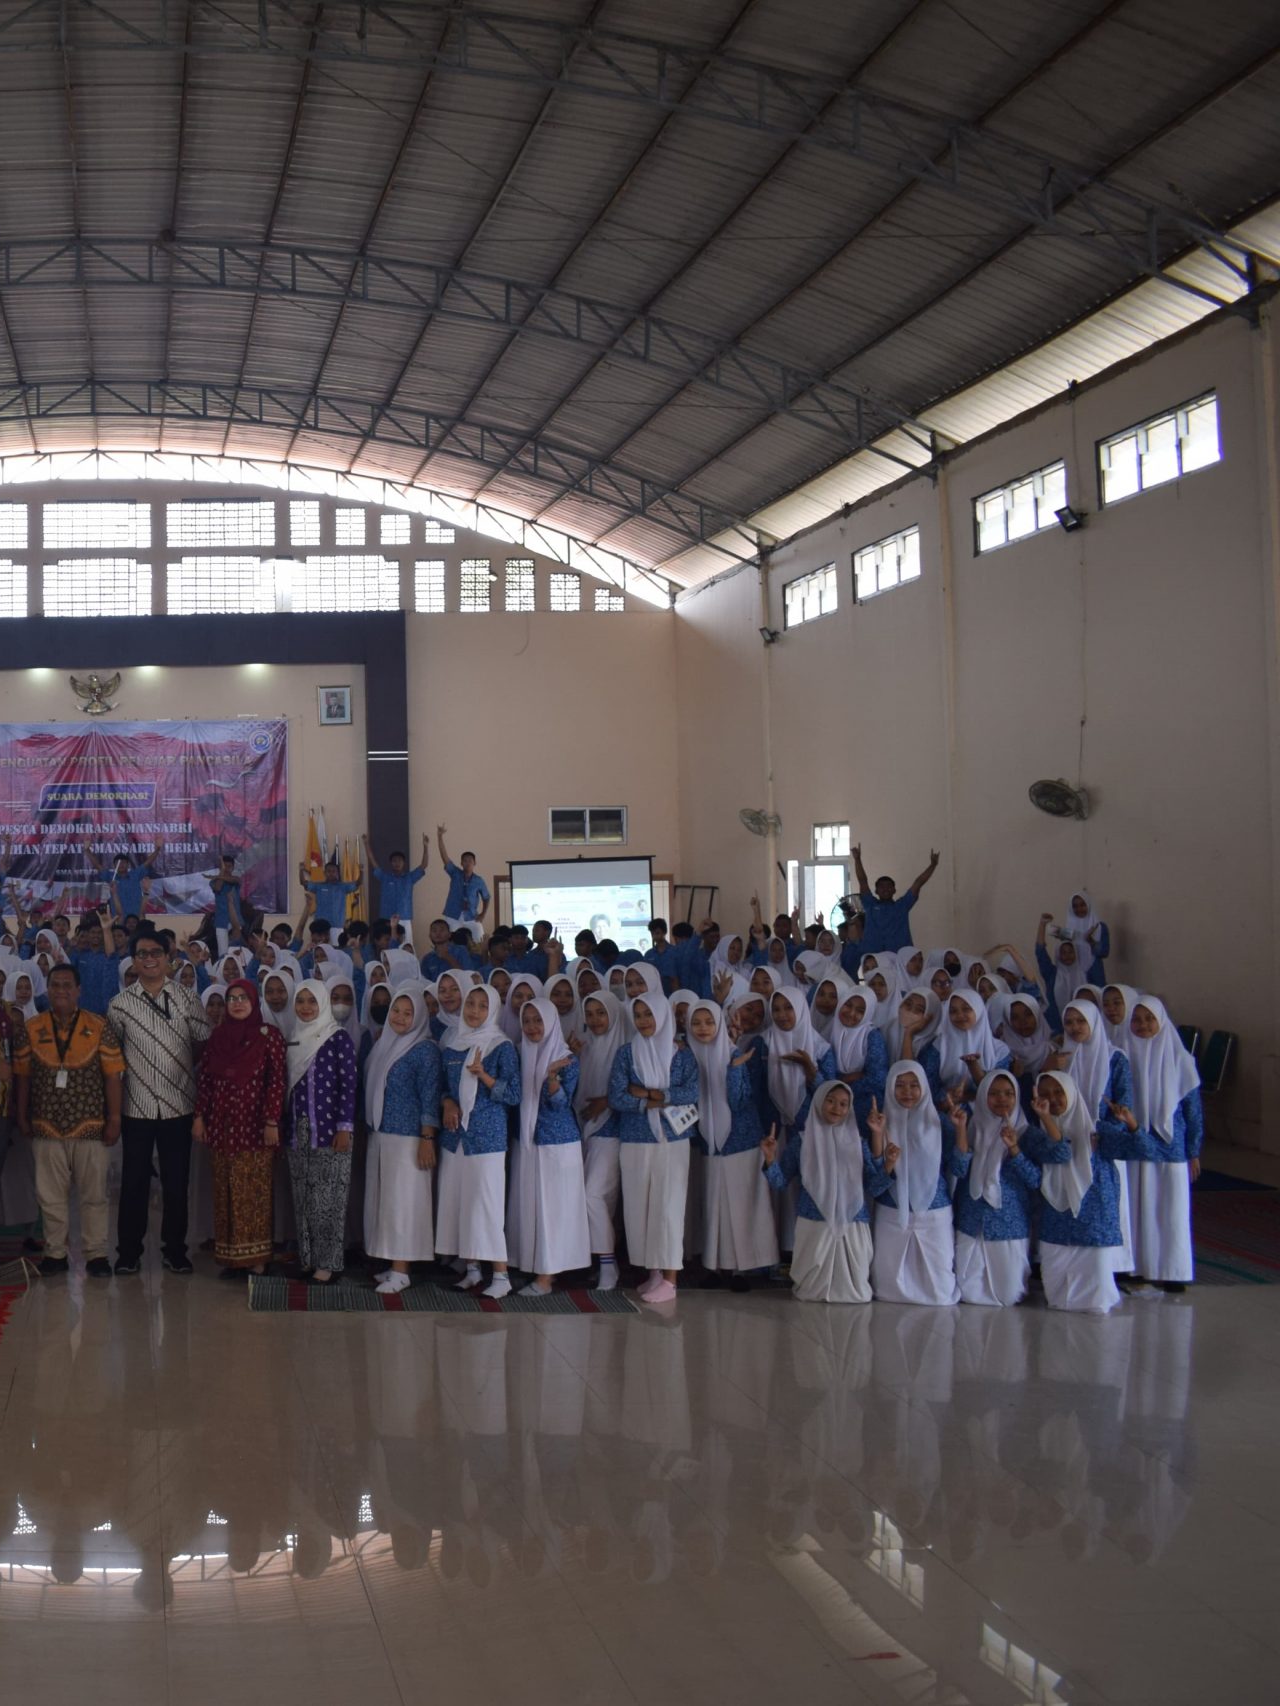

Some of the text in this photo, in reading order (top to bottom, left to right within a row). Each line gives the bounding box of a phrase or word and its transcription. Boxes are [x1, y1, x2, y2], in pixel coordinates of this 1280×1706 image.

[48, 791, 148, 801] SUARA DEMOKRASI
[40, 823, 114, 834] DEMOKRASI
[118, 823, 192, 833] SMANSABRI
[43, 843, 82, 854] TEPAT
[164, 842, 208, 853] HEBAT
